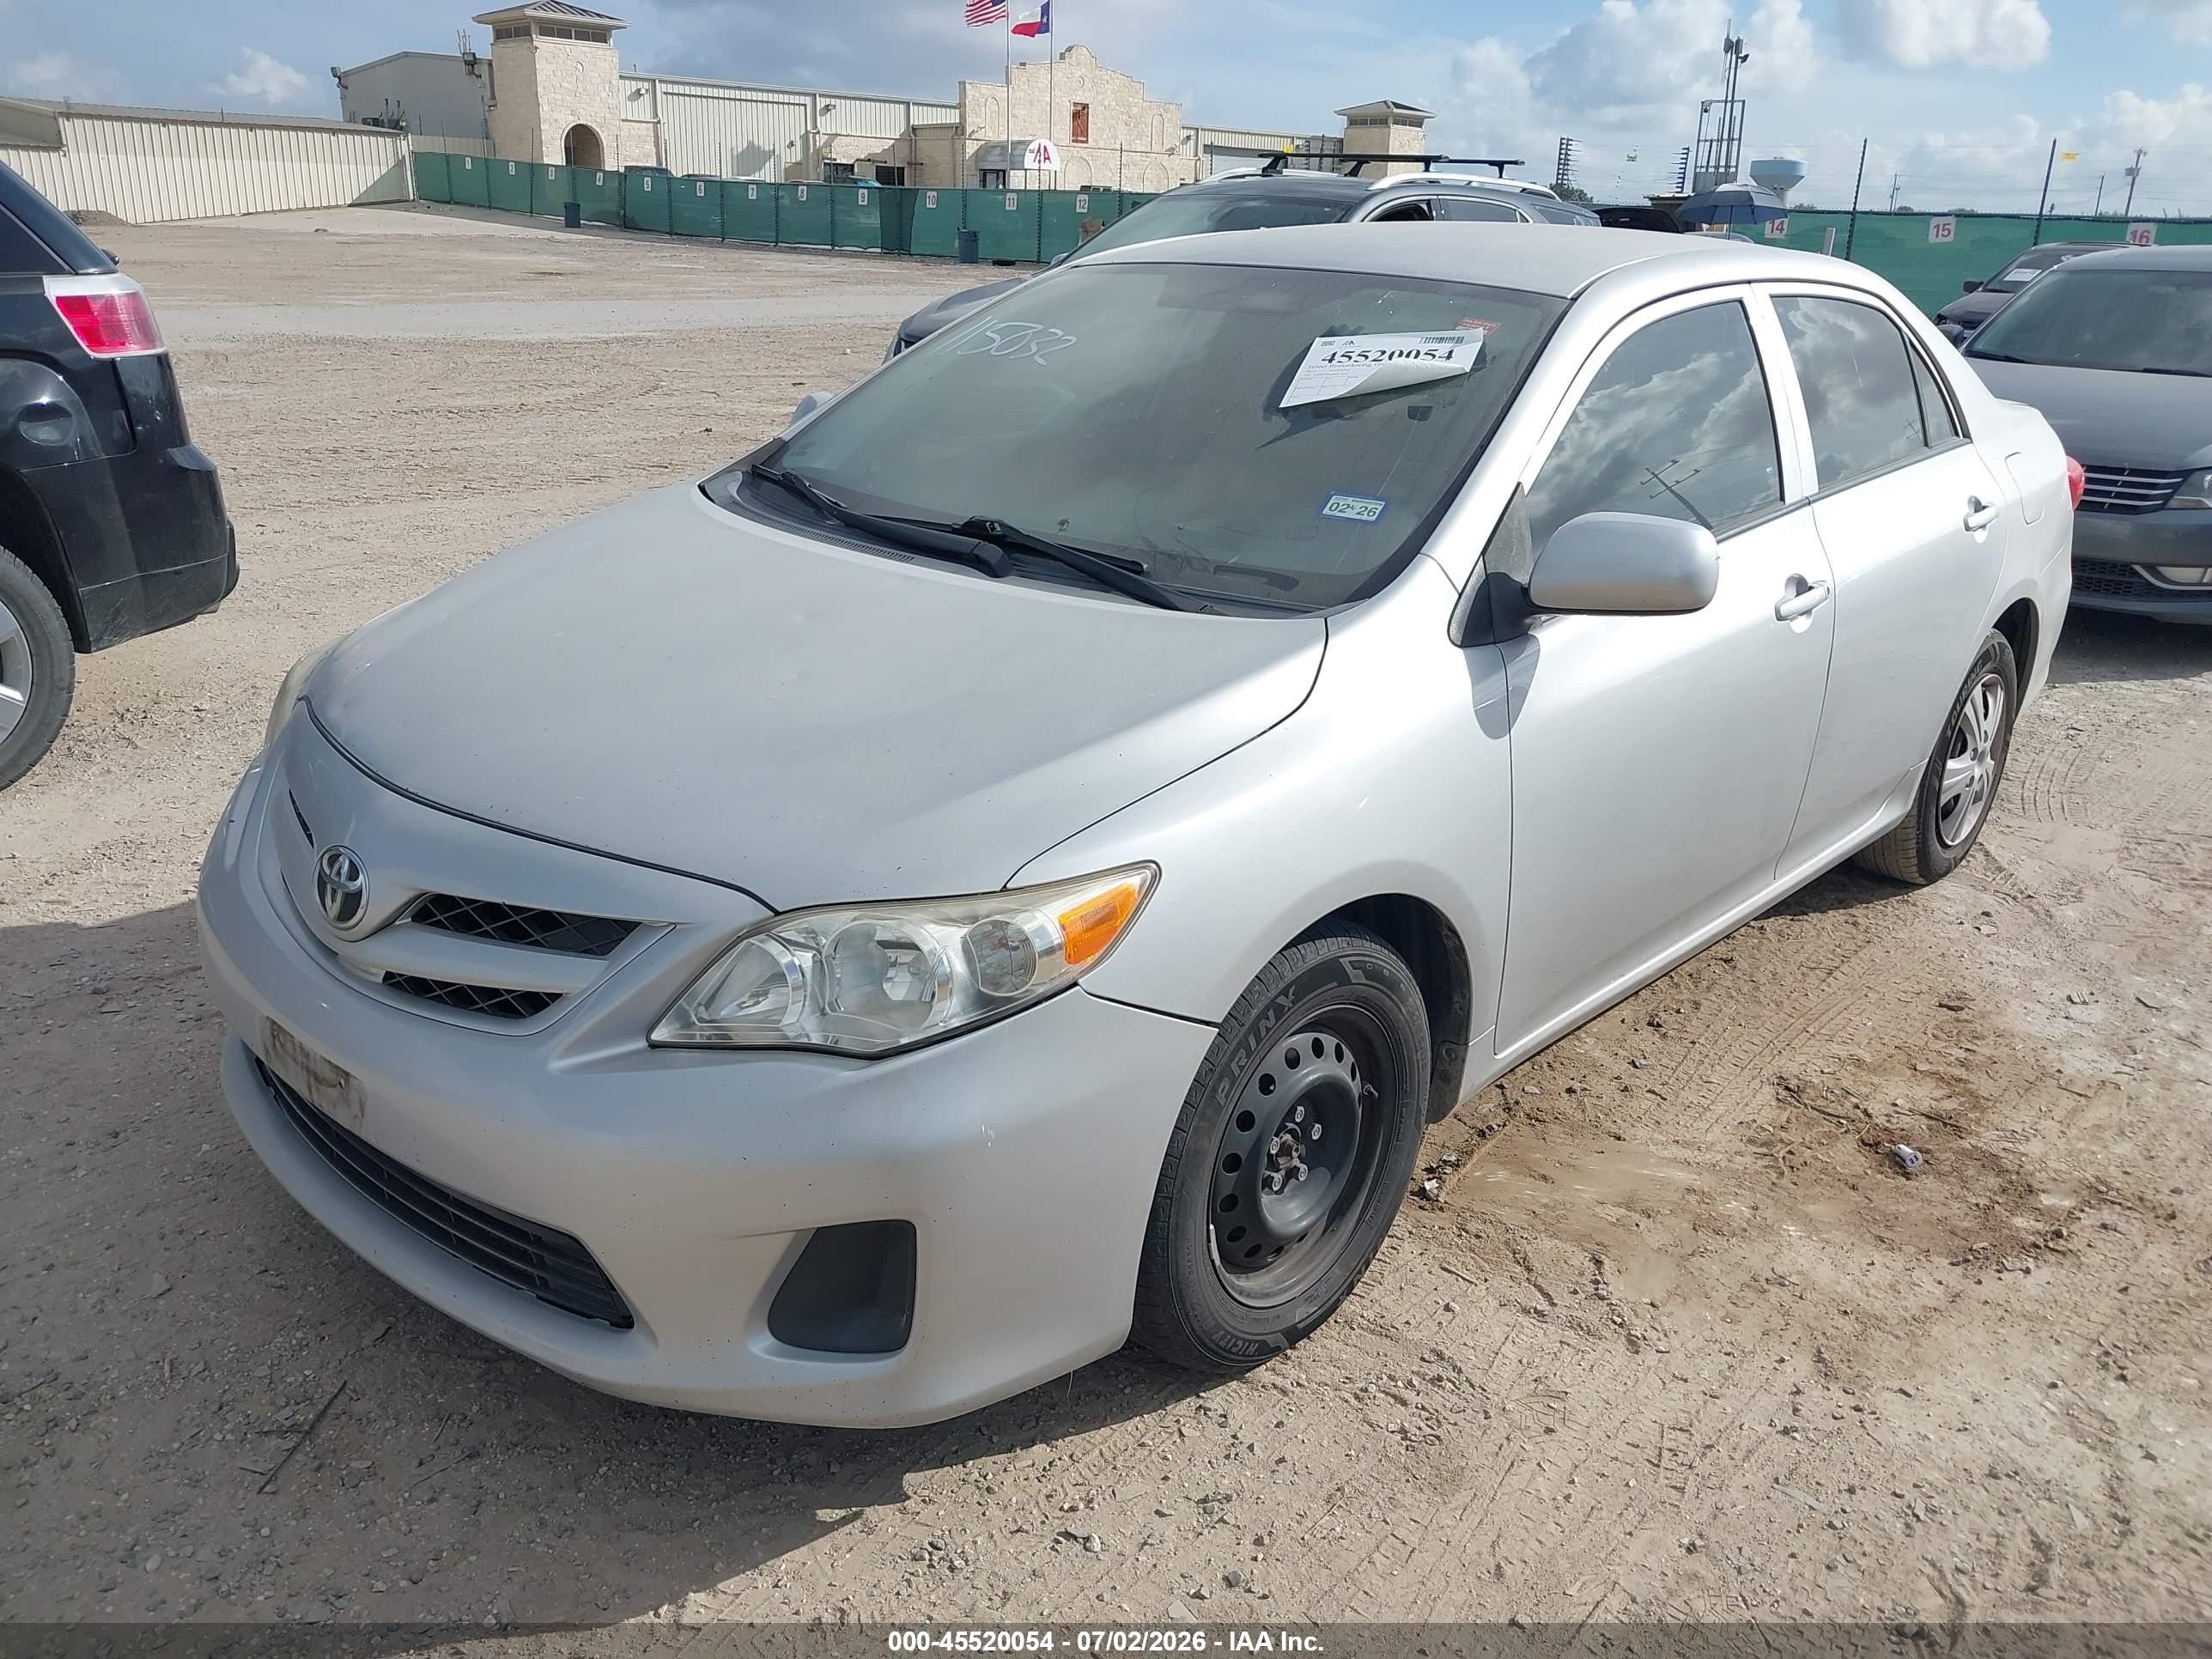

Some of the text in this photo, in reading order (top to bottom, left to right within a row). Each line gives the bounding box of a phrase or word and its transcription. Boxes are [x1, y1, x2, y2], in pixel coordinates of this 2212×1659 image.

[860, 191, 866, 203] 9
[927, 194, 937, 206] 10
[1006, 197, 1016, 208] 11
[1078, 198, 1087, 210] 12
[1769, 219, 1785, 234] 14
[1933, 222, 1952, 238] 15
[2130, 229, 2151, 244] 16
[1321, 349, 1455, 364] 45520054
[1328, 501, 1351, 514] 02
[1355, 505, 1379, 518] 26
[1214, 984, 1297, 1107] PRINX
